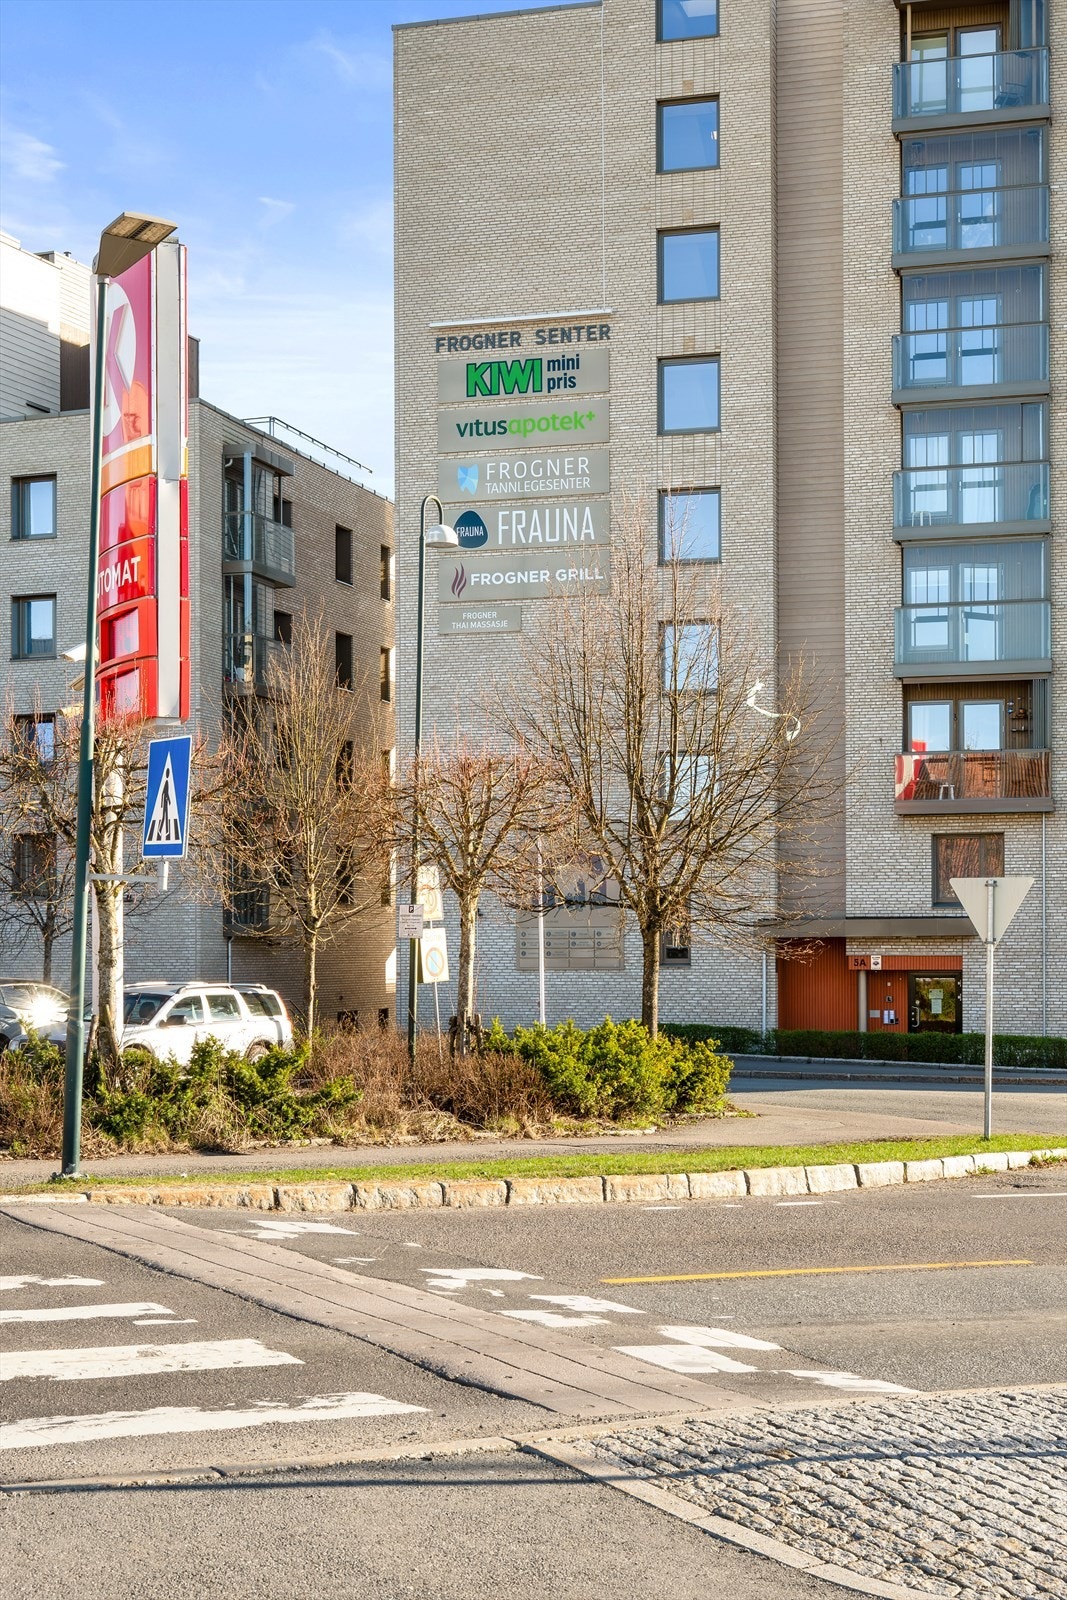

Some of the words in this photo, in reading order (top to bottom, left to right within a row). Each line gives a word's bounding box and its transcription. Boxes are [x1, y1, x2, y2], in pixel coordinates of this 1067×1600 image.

[435, 330, 522, 353] FROGNER
[535, 323, 611, 345] SENTER
[547, 353, 580, 372] mini
[466, 358, 543, 397] KIWI
[547, 373, 577, 393] pris
[486, 457, 590, 480] FROGNER
[485, 477, 591, 495] TANNLEGESENTER
[456, 525, 484, 538] FRAUNA
[498, 506, 595, 545] FRAUNA
[470, 570, 551, 586] FROGNER
[555, 568, 604, 582] GRILL
[452, 621, 469, 630] THAI
[470, 620, 508, 629] MASSASJE
[462, 611, 497, 620] FROGNER
